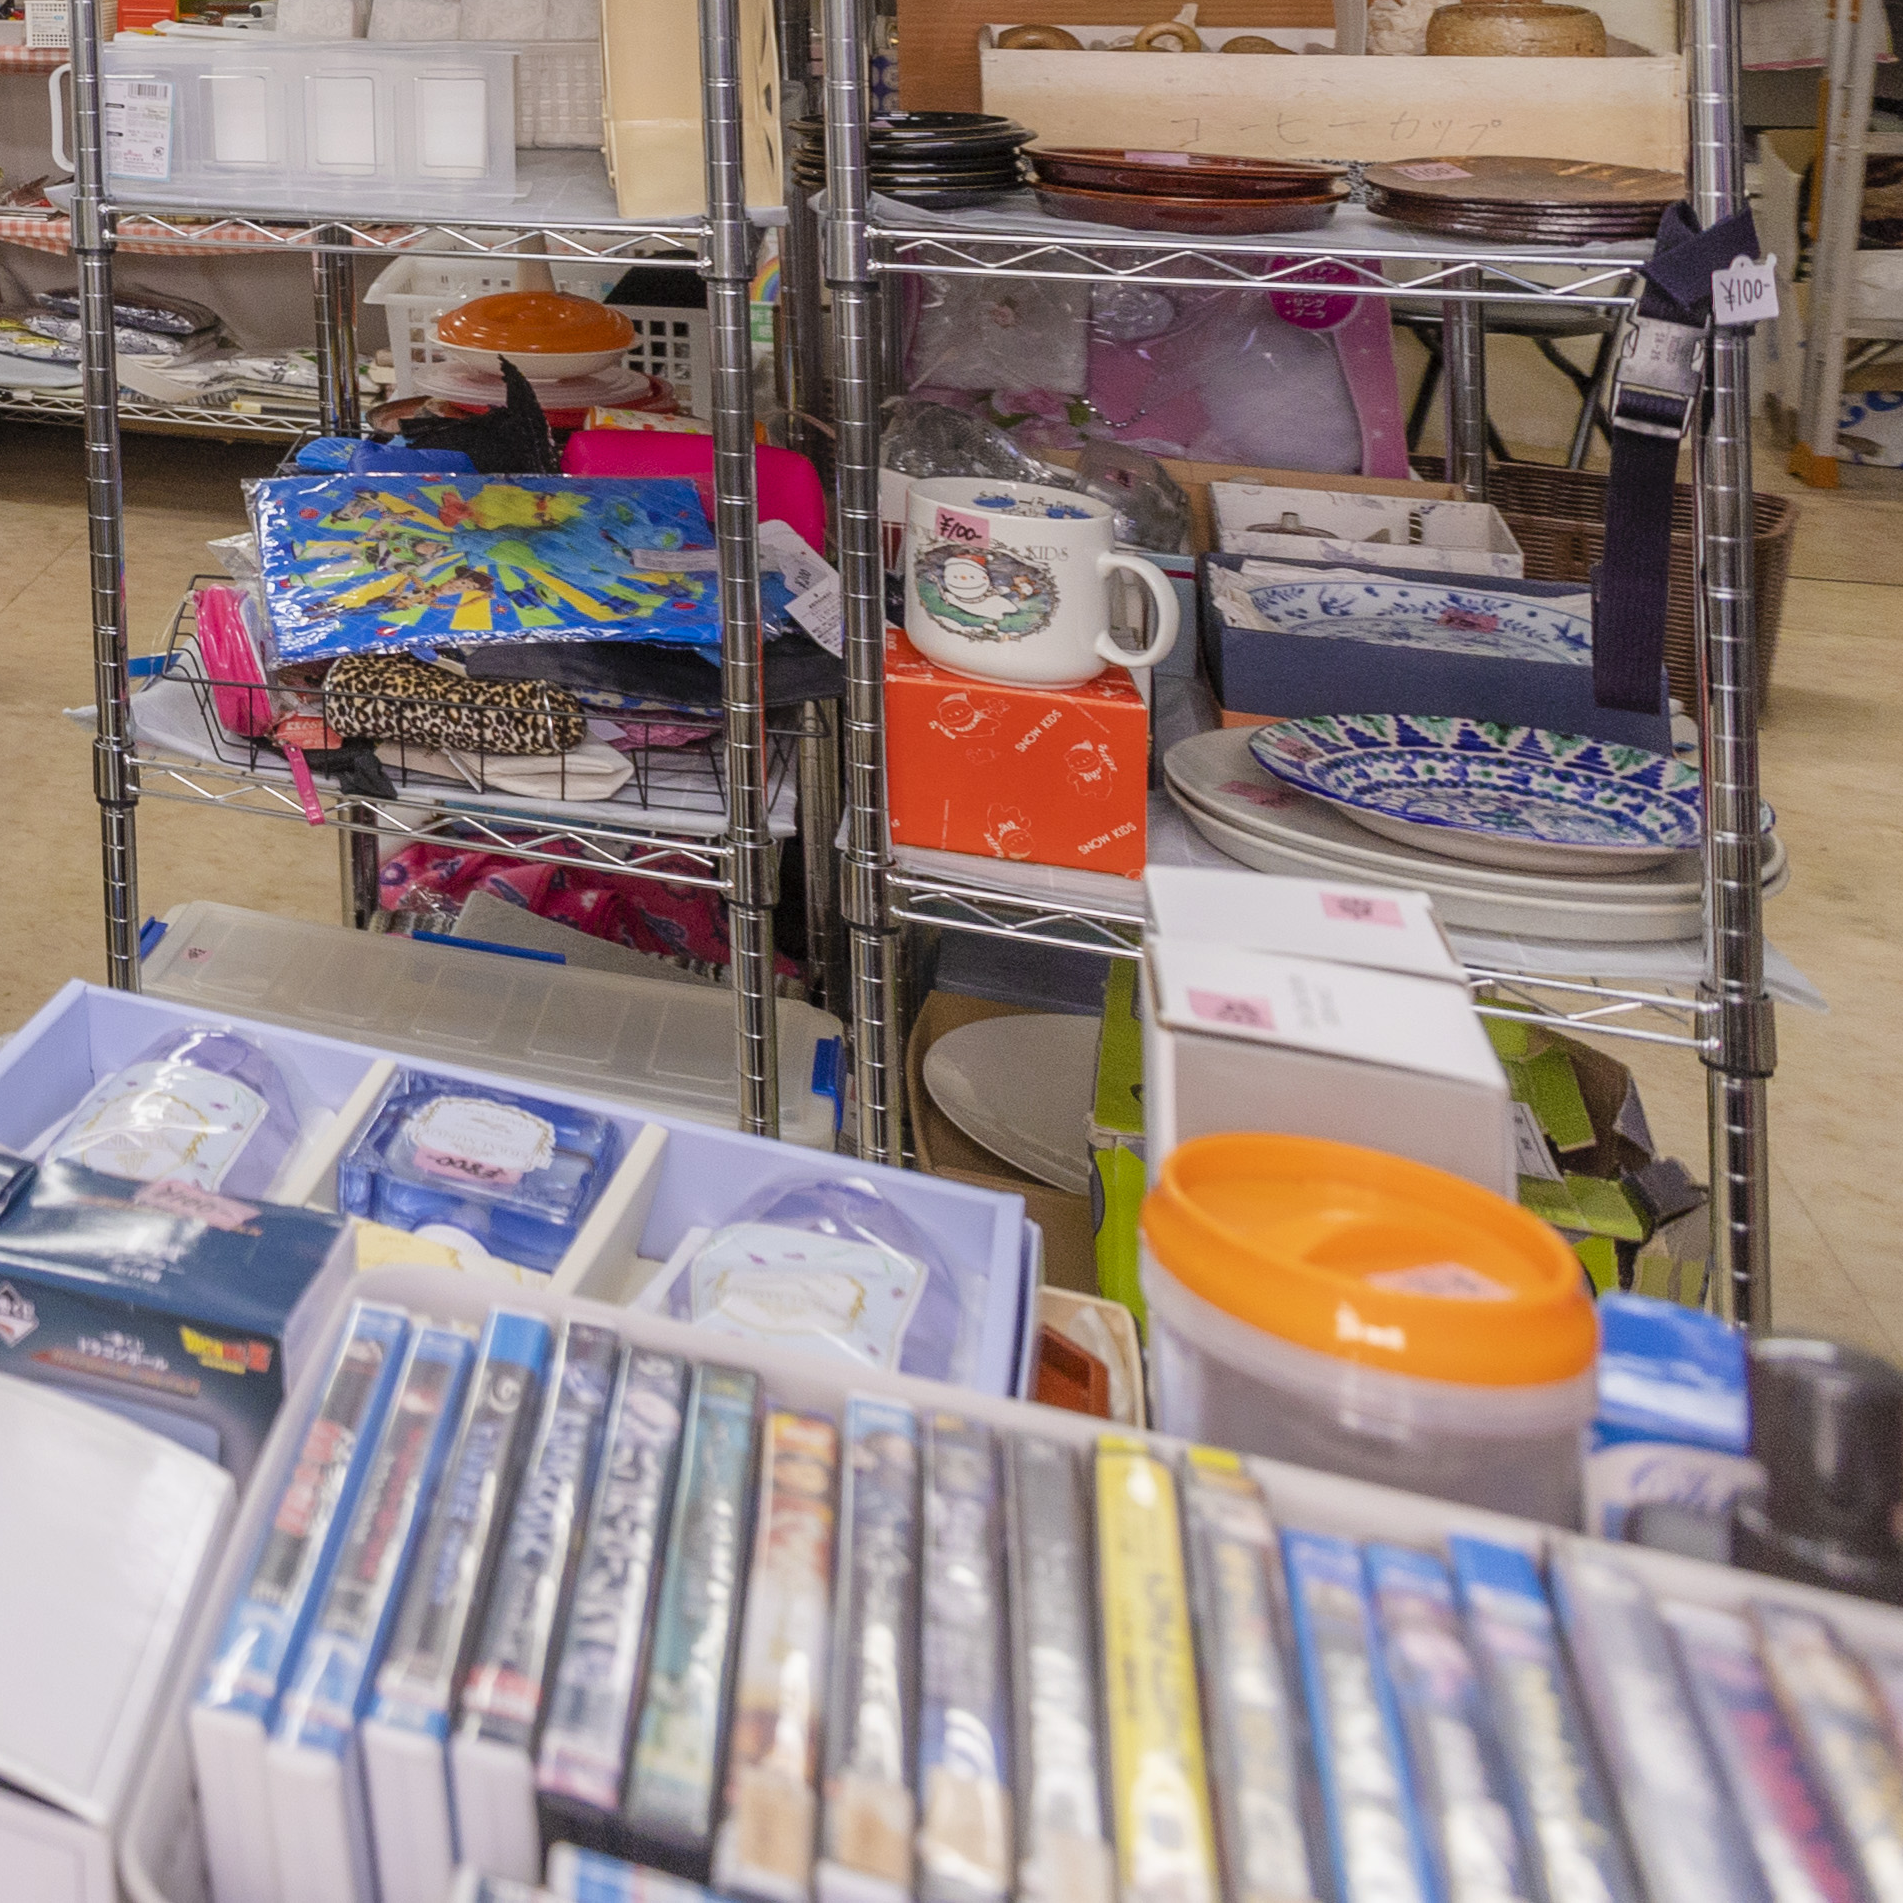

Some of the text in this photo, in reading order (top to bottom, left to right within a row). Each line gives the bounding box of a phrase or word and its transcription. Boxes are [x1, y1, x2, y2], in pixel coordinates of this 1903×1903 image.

[1174, 116, 1504, 149] コーヒーカップ
[1719, 278, 1771, 312] ¥100-
[939, 514, 984, 541] ¥100-
[1028, 544, 1070, 561] KIDS
[1014, 709, 1063, 753] SNOW KIDS
[1077, 821, 1138, 855] SNOW KIDS
